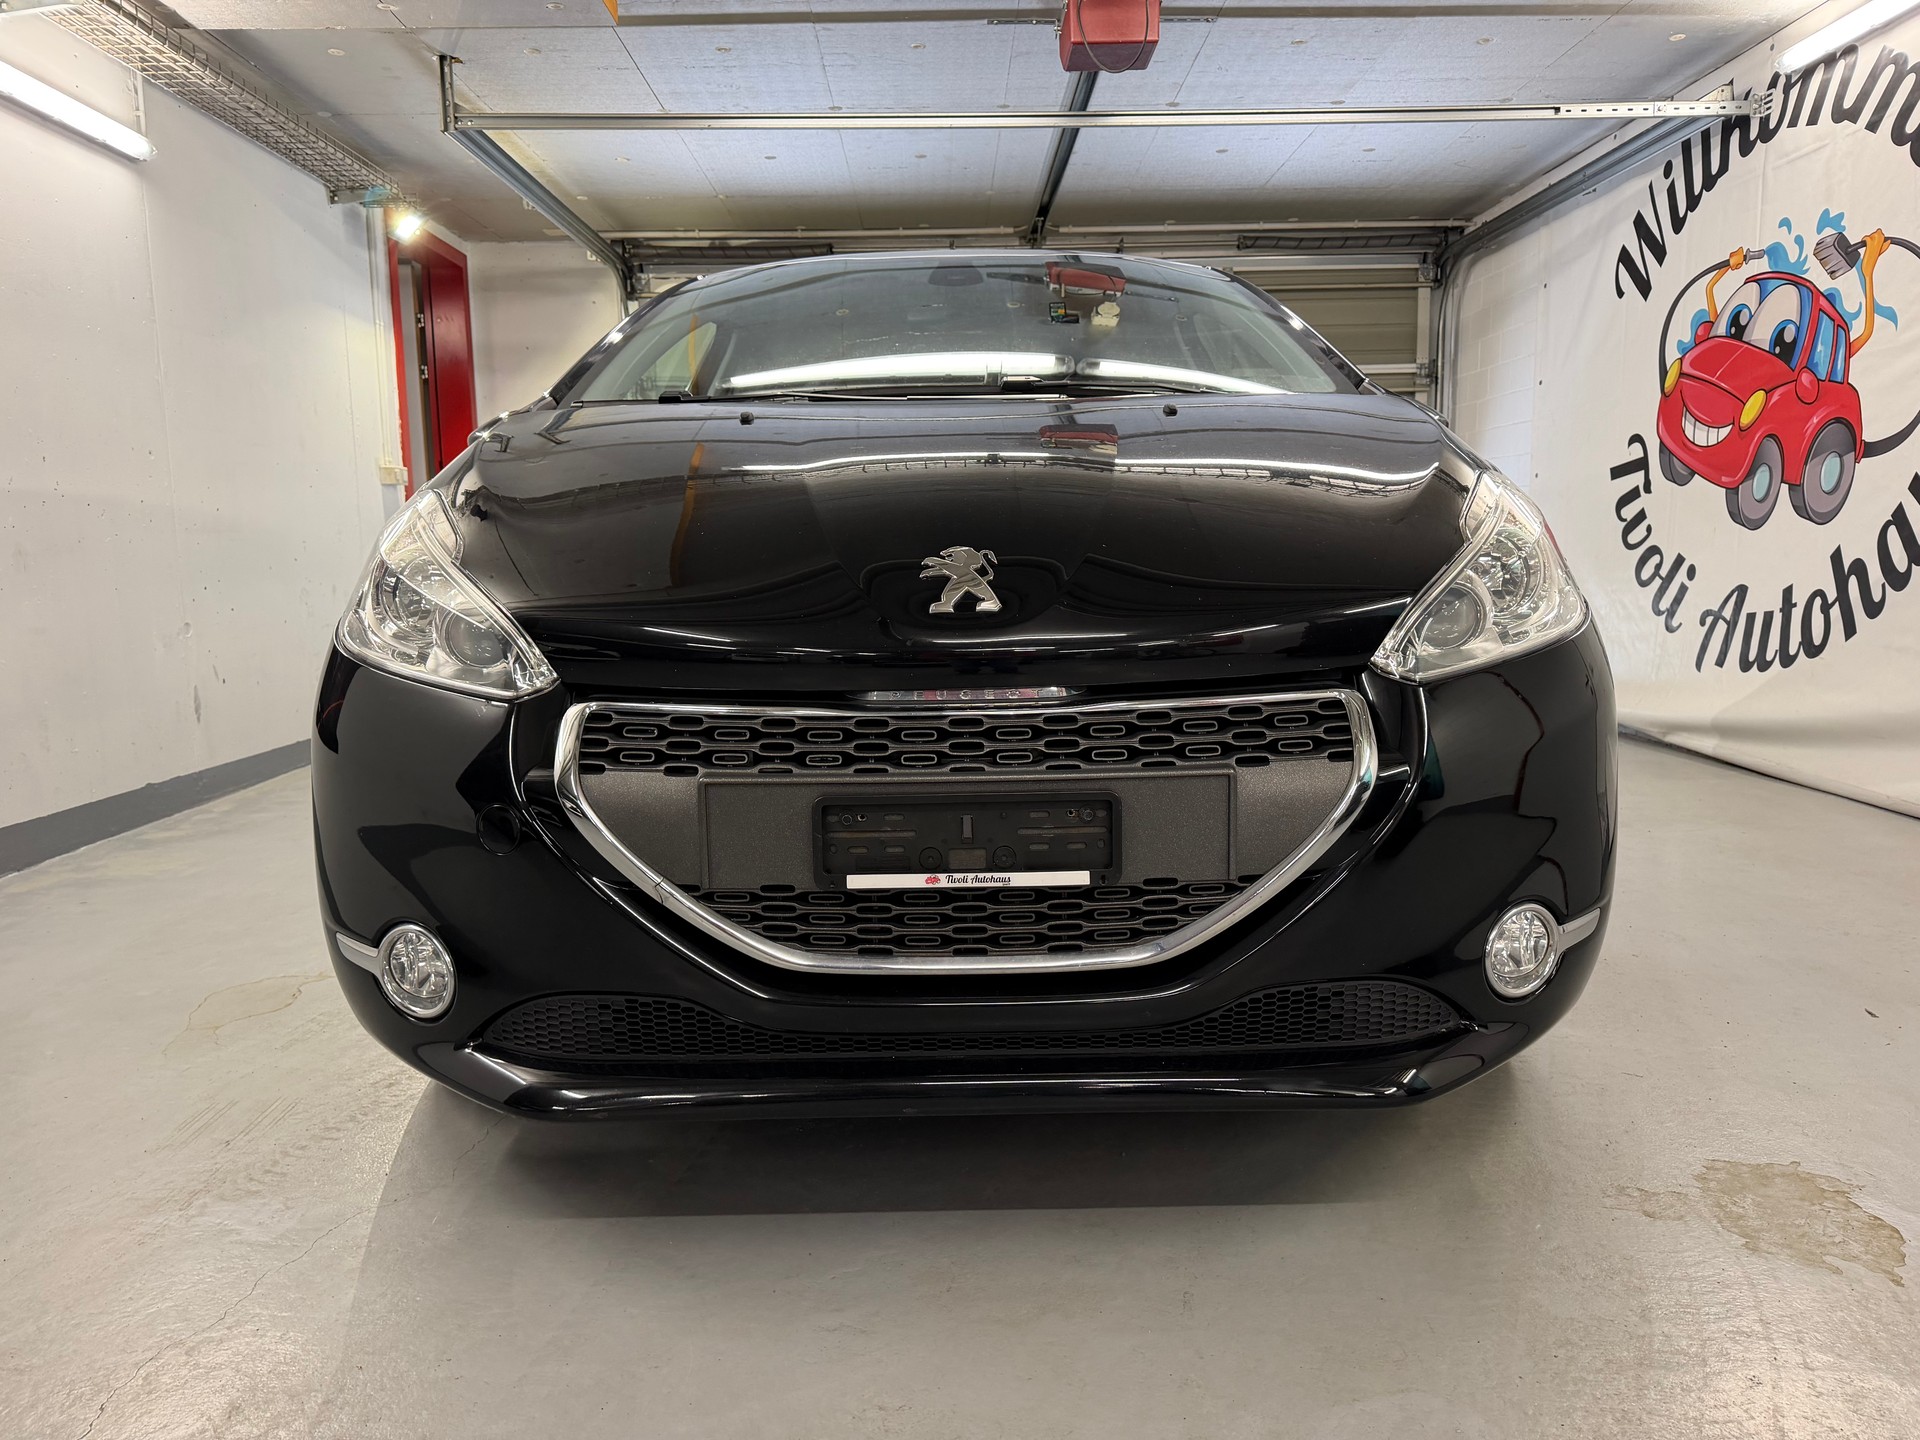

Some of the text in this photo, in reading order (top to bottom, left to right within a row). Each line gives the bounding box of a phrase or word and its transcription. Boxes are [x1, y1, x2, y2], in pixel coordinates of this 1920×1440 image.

[1615, 43, 1920, 302] Willkomm
[1609, 433, 1696, 634] Tivoli
[945, 874, 1011, 884] Tivoli Autohaus
